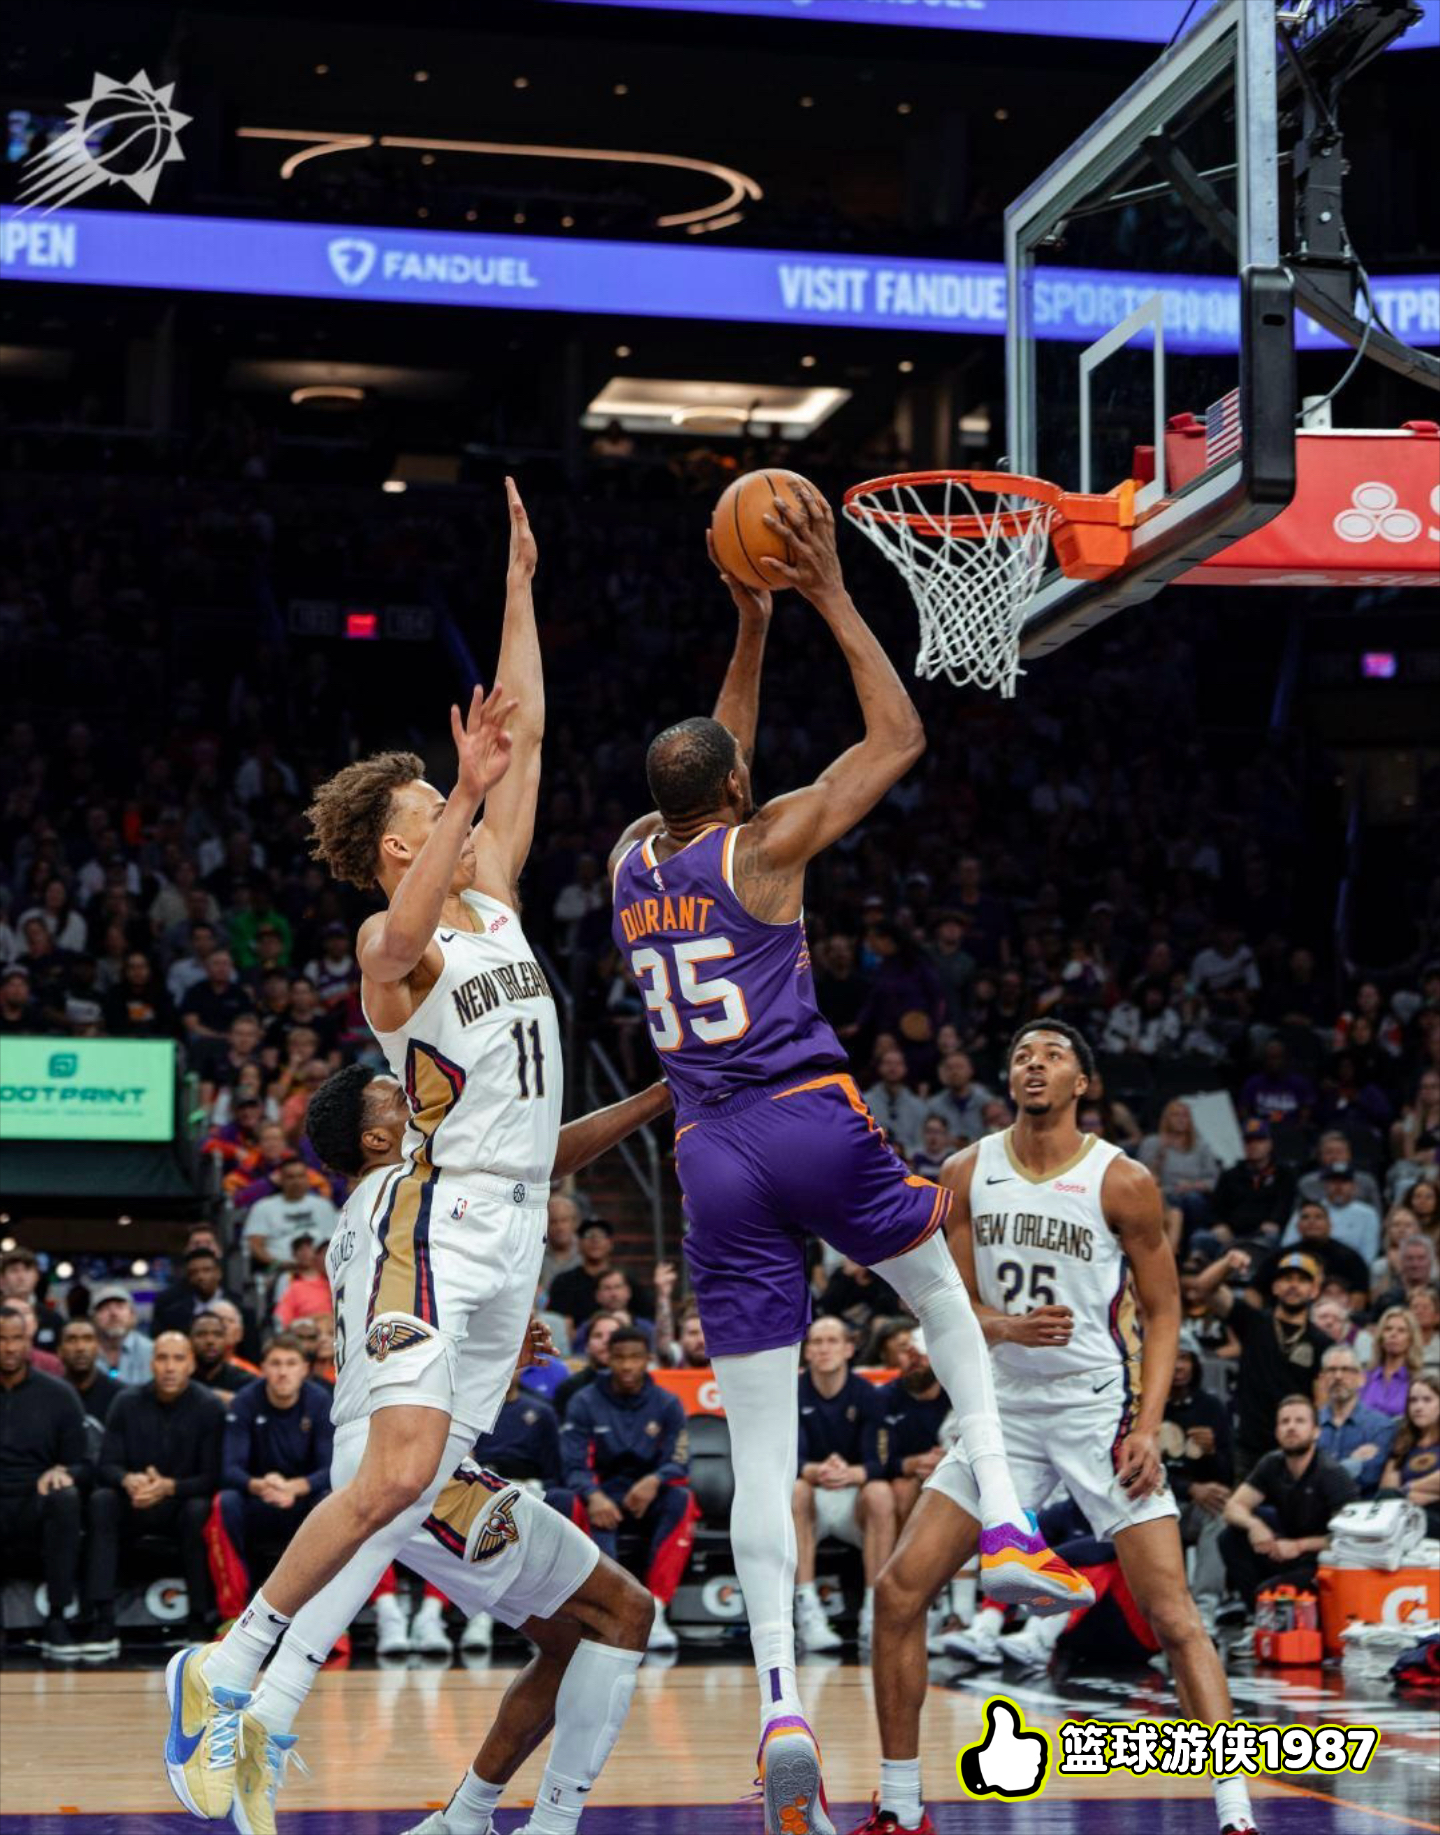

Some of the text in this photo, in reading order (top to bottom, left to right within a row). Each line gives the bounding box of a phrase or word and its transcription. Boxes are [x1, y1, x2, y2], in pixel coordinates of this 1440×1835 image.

[0, 221, 76, 269] PEN
[382, 250, 539, 288] FANDUEL
[778, 265, 868, 313] VISIT
[619, 896, 715, 944] DURANT
[452, 961, 555, 1028] NEW ORLEAN
[631, 936, 750, 1051] 35
[510, 1018, 544, 1100] 11
[1013, 1212, 1094, 1262] ORLEANS
[996, 1259, 1057, 1316] 25
[145, 1578, 189, 1620] G
[702, 1576, 745, 1617] G
[1382, 1586, 1428, 1626] G
